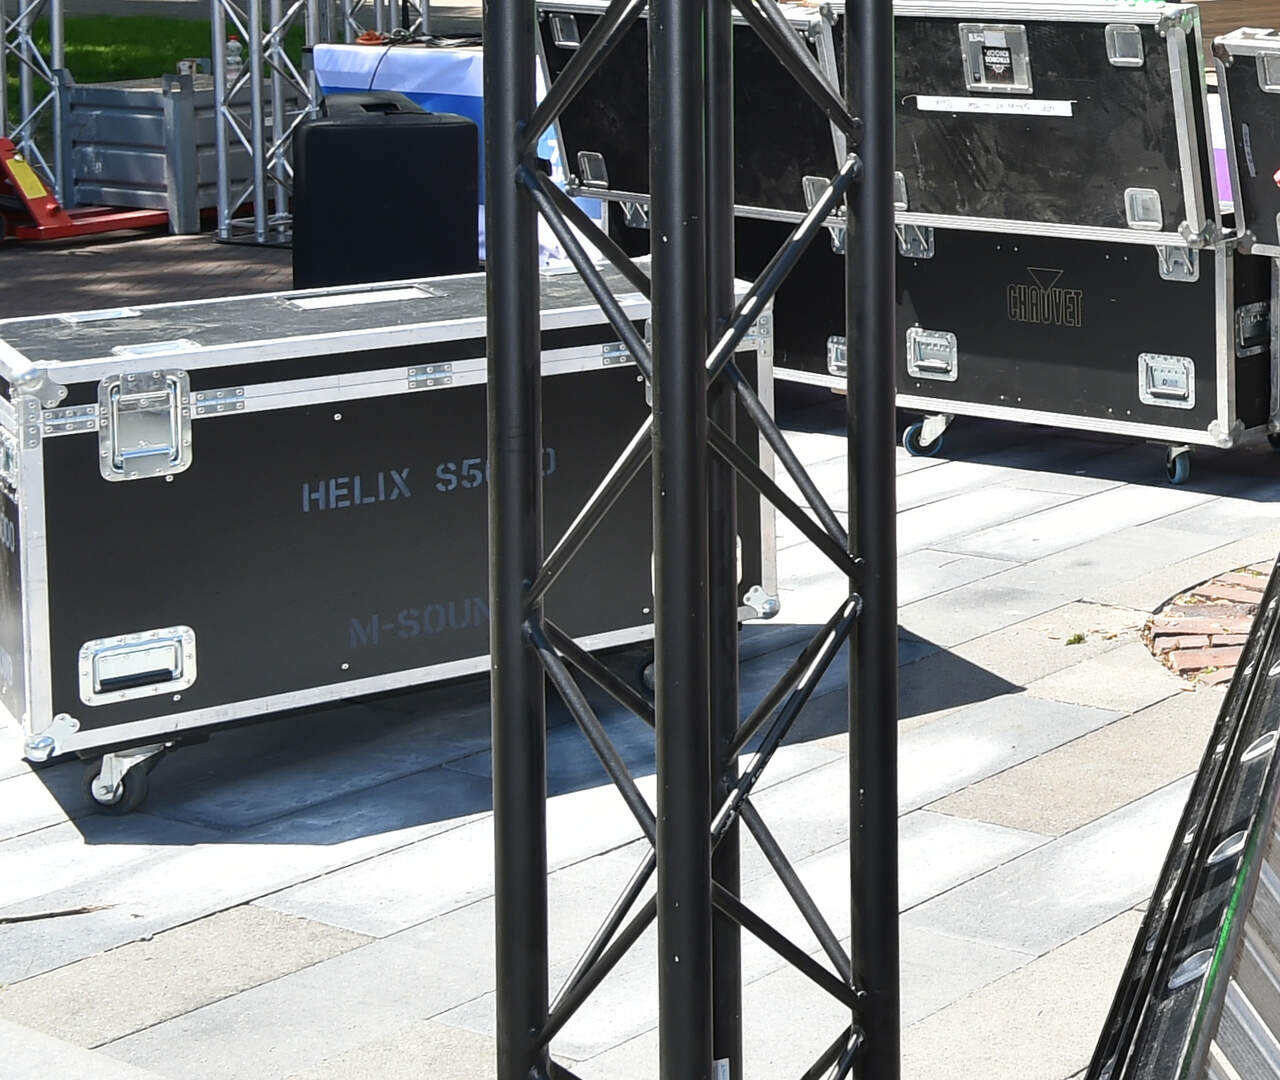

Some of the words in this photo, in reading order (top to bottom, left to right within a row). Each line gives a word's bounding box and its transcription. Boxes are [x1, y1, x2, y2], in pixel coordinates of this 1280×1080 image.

[1007, 283, 1083, 328] CHAUVET
[303, 468, 412, 512] HELIX
[435, 448, 556, 492] S50
[350, 597, 490, 649] M-SOUN
